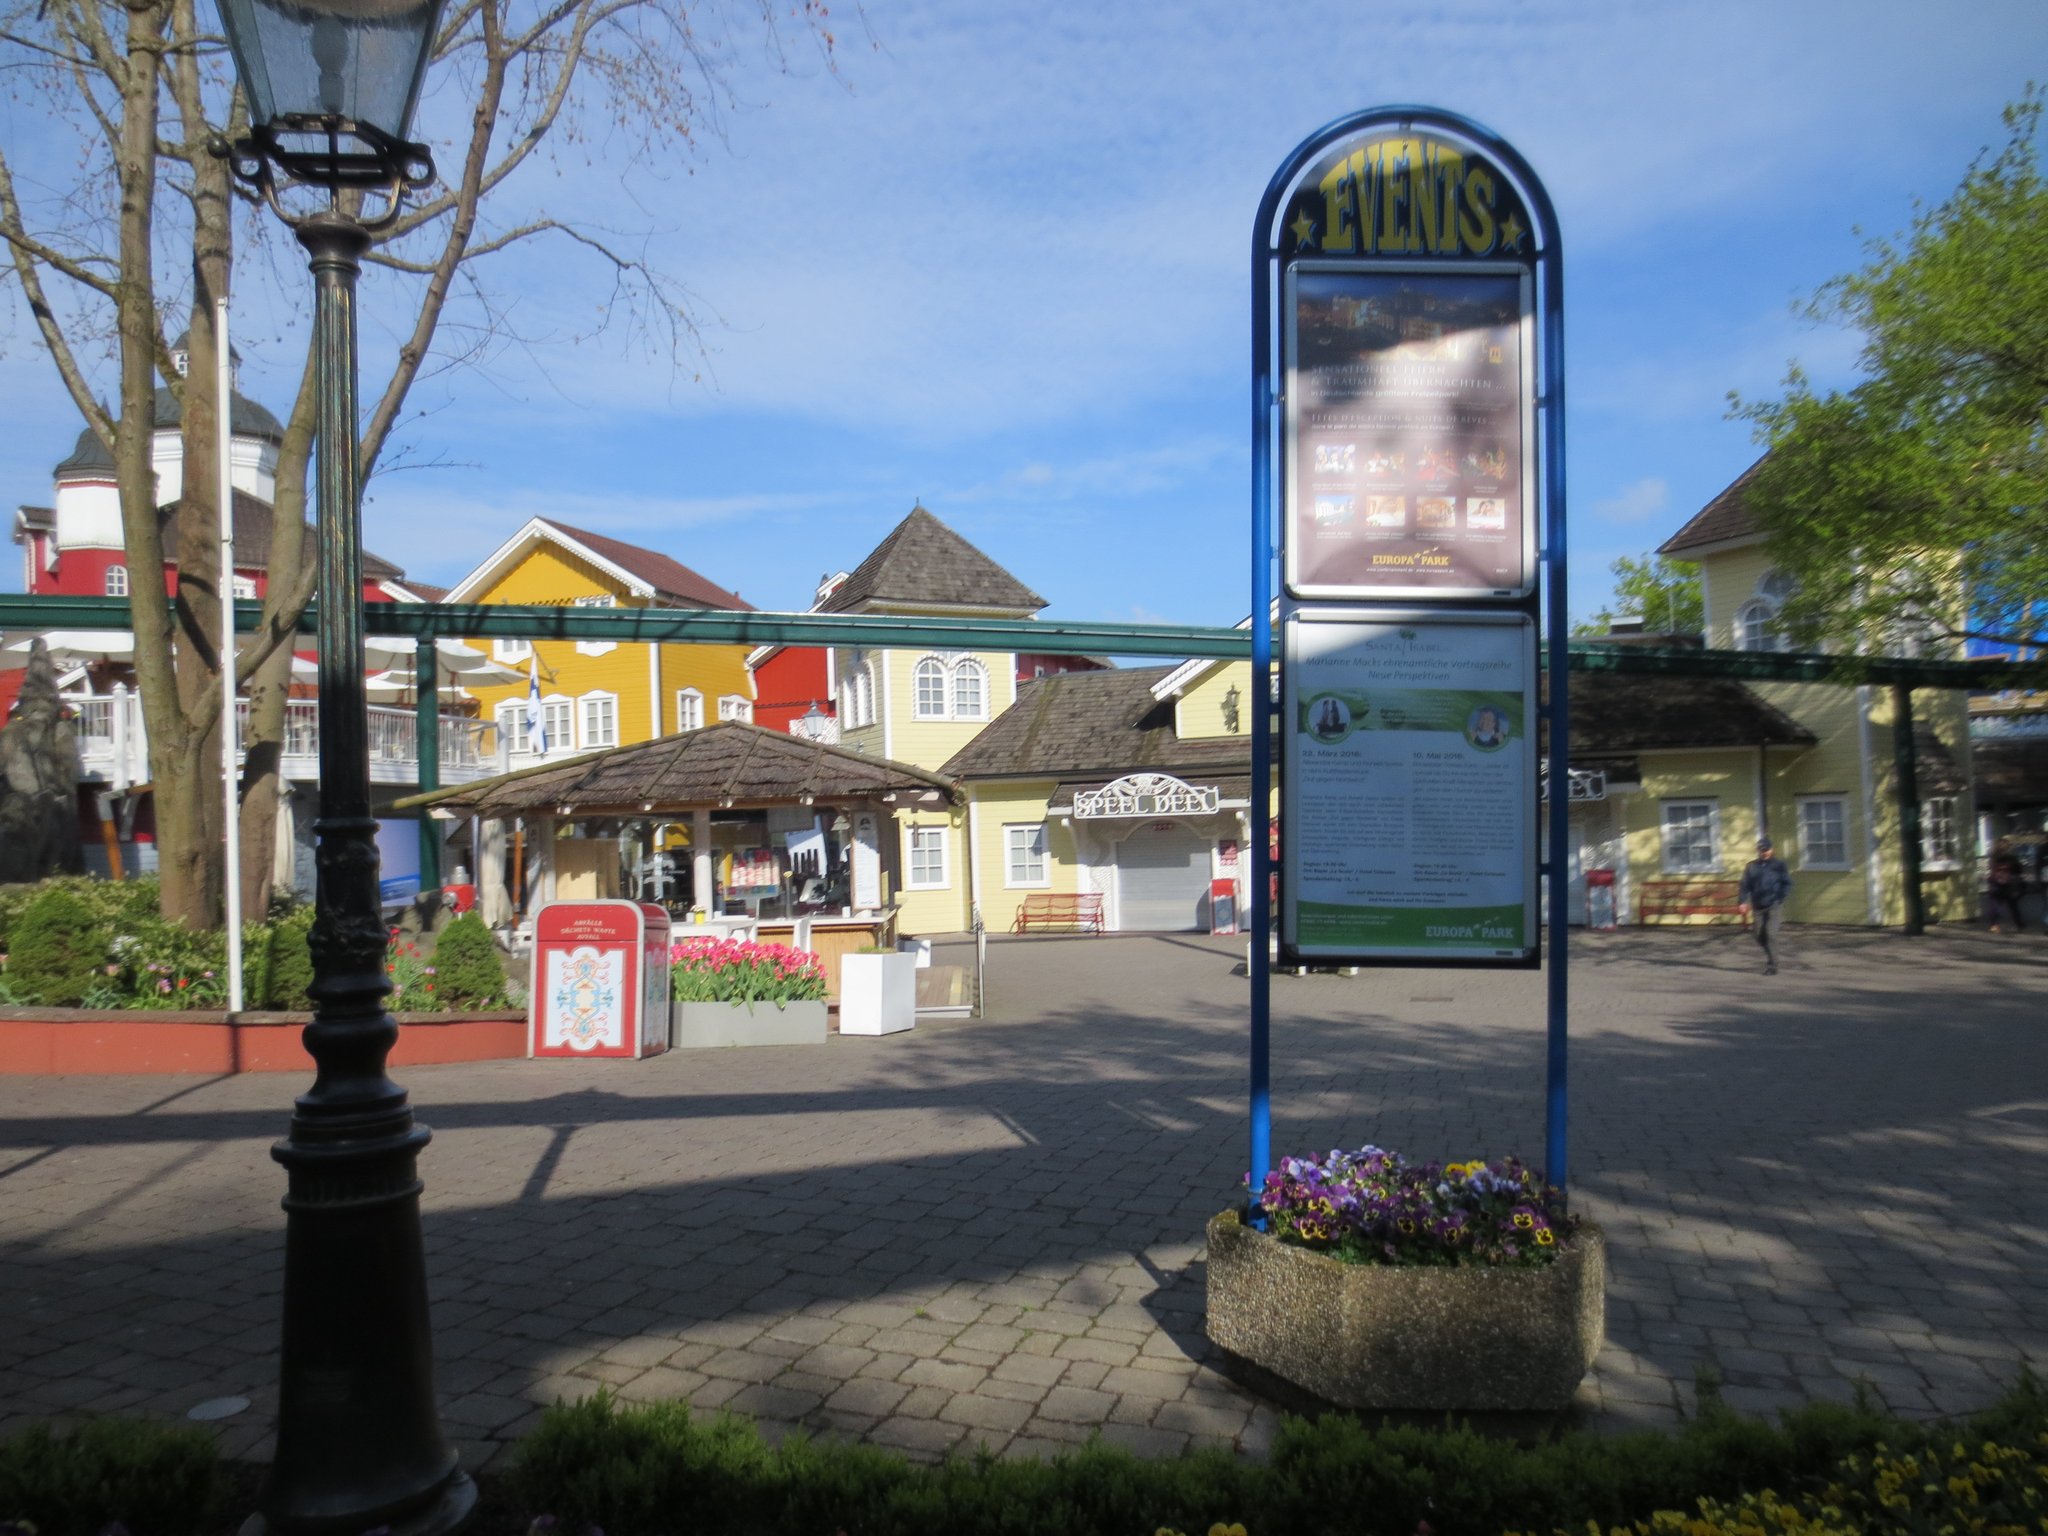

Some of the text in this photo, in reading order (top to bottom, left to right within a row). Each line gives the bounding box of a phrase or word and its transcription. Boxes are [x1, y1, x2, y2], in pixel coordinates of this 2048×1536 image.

[1319, 139, 1497, 256] EVENTS
[1372, 554, 1449, 566] EUROPA PARK
[1077, 796, 1149, 817] SPEEL
[1425, 925, 1514, 939] EUROPA PARK
